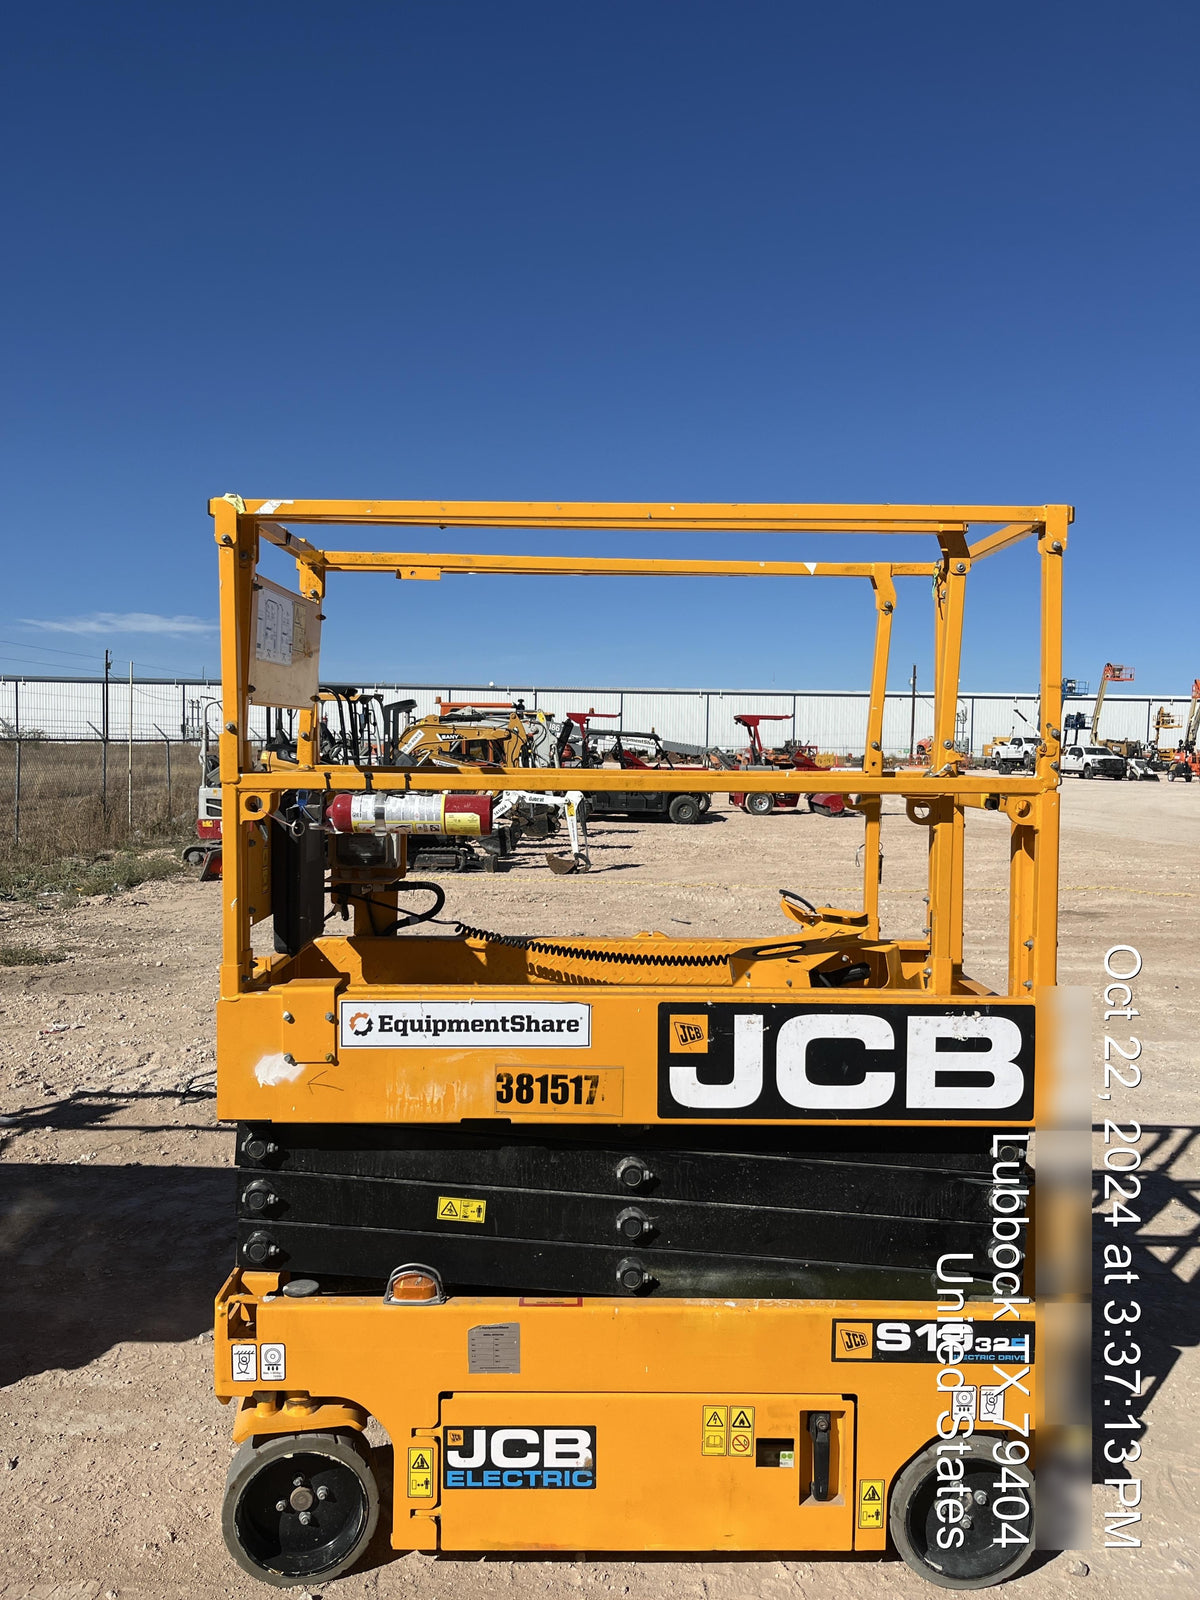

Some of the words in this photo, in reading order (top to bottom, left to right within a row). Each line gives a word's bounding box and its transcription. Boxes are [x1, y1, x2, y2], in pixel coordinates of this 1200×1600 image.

[377, 1014, 581, 1037] EquipmentShare
[679, 1023, 703, 1044] JCB
[669, 1013, 1025, 1109] JCB
[495, 1072, 600, 1105] 381517
[844, 1331, 868, 1350] JCB
[447, 1429, 593, 1468] JCB
[446, 1470, 593, 1487] ELECTRIC
